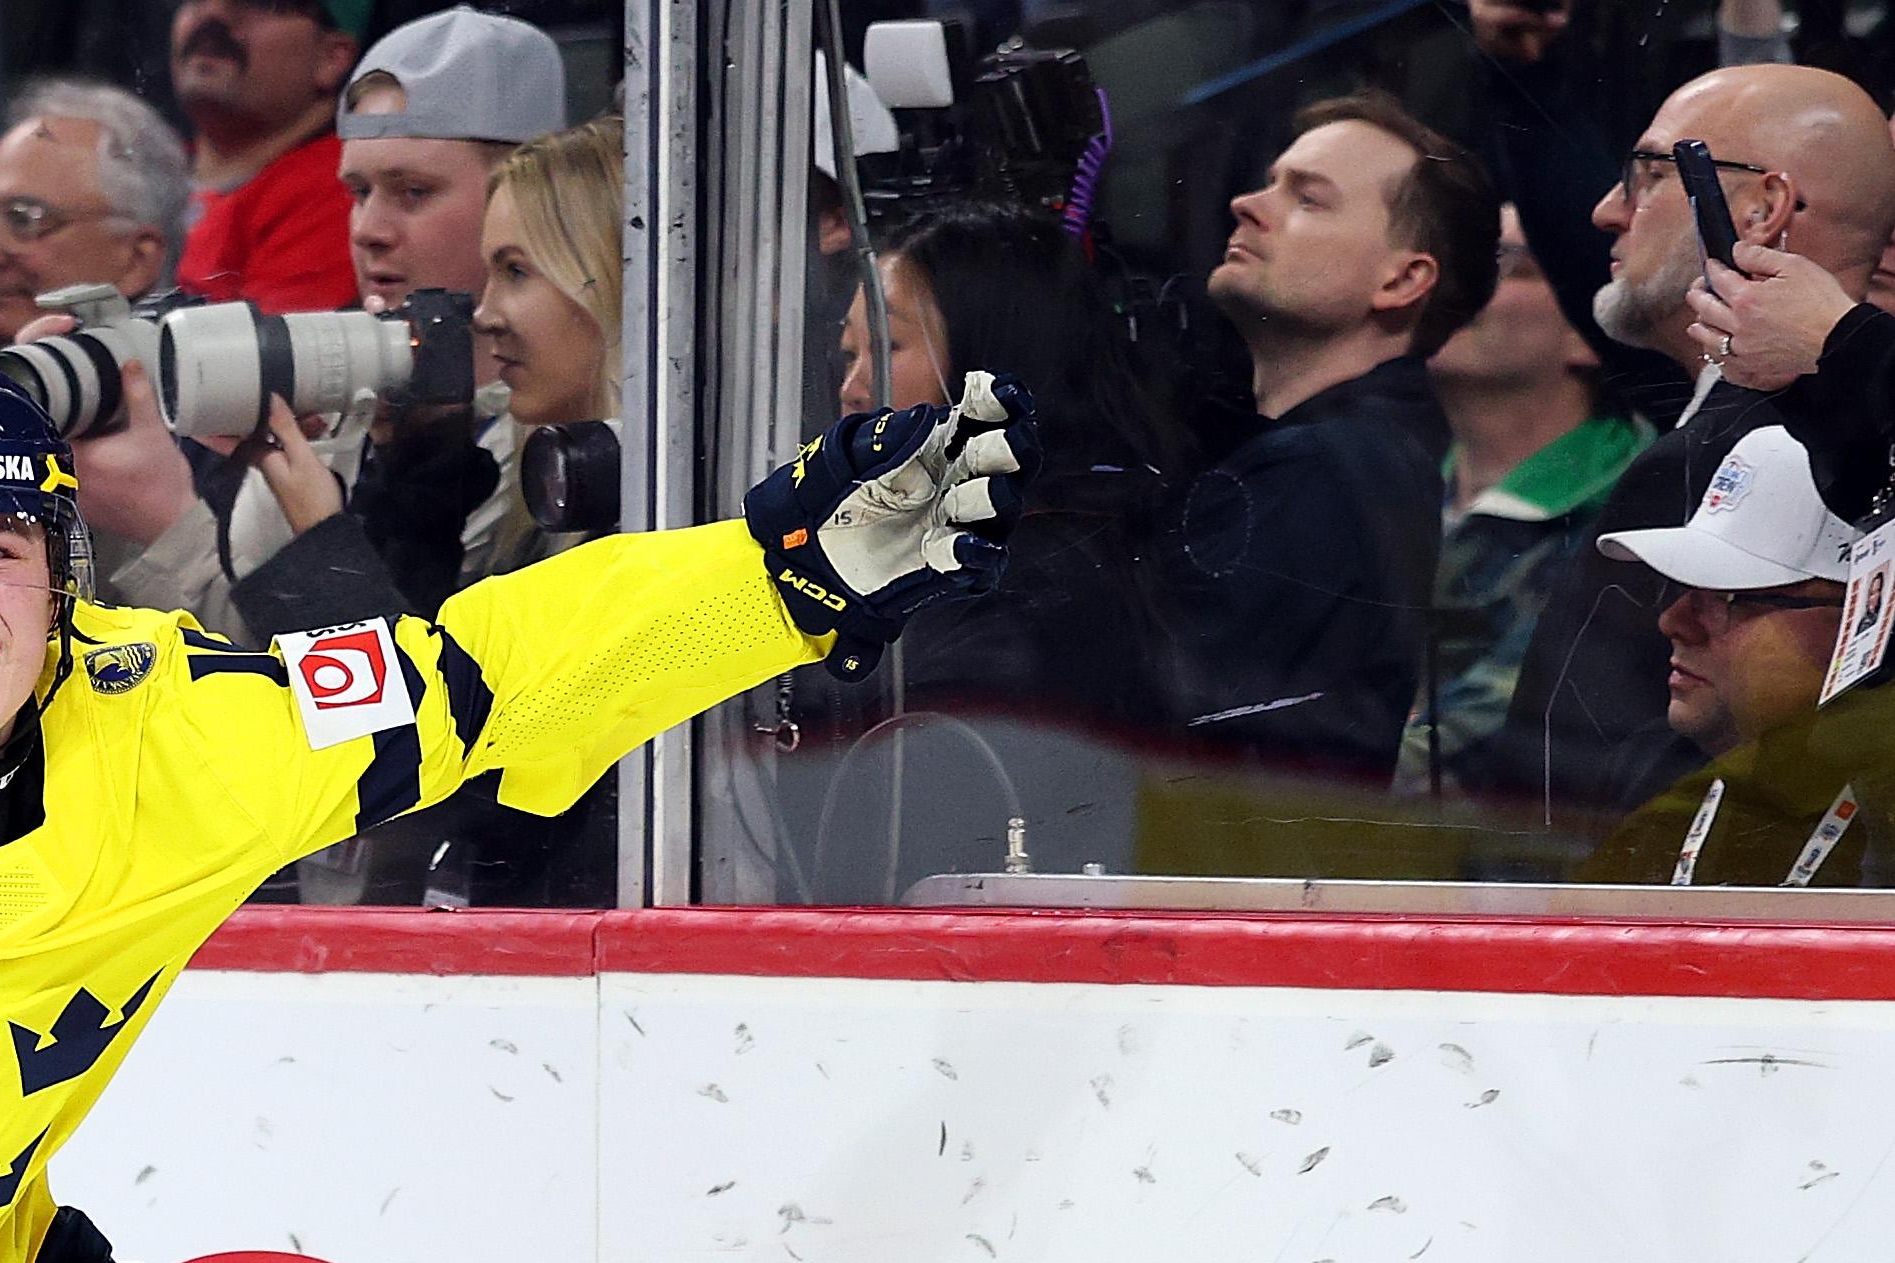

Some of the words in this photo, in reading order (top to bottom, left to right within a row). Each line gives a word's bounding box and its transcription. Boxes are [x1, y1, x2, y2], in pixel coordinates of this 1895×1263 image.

[833, 509, 852, 526] 15
[778, 567, 848, 613] CCM
[844, 657, 860, 672] 15
